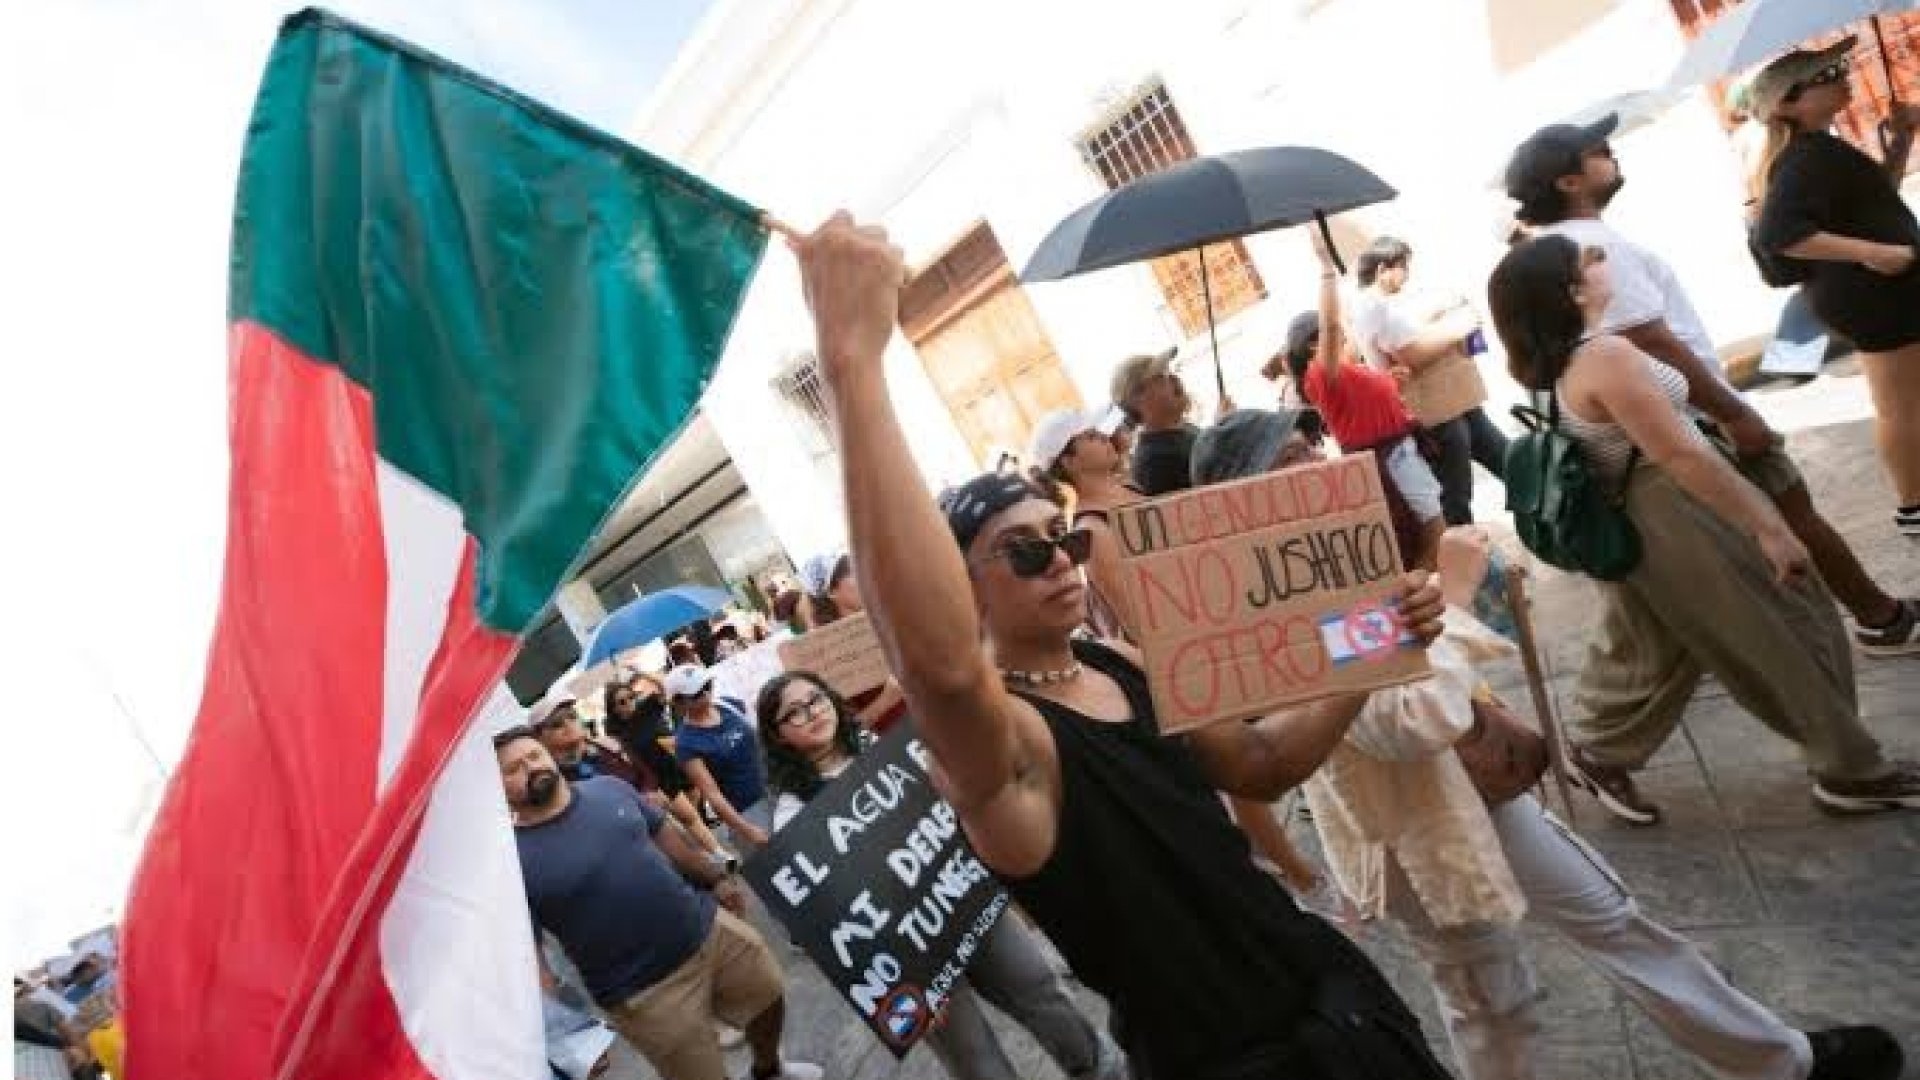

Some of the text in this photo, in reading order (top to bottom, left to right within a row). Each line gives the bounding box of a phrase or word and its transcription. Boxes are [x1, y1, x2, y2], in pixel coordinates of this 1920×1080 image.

[1136, 550, 1237, 630] NO
[1166, 614, 1325, 717] OTRO
[770, 851, 831, 907] EL
[827, 763, 918, 854] AGUA
[831, 888, 891, 968] MI
[850, 952, 901, 1016] NO
